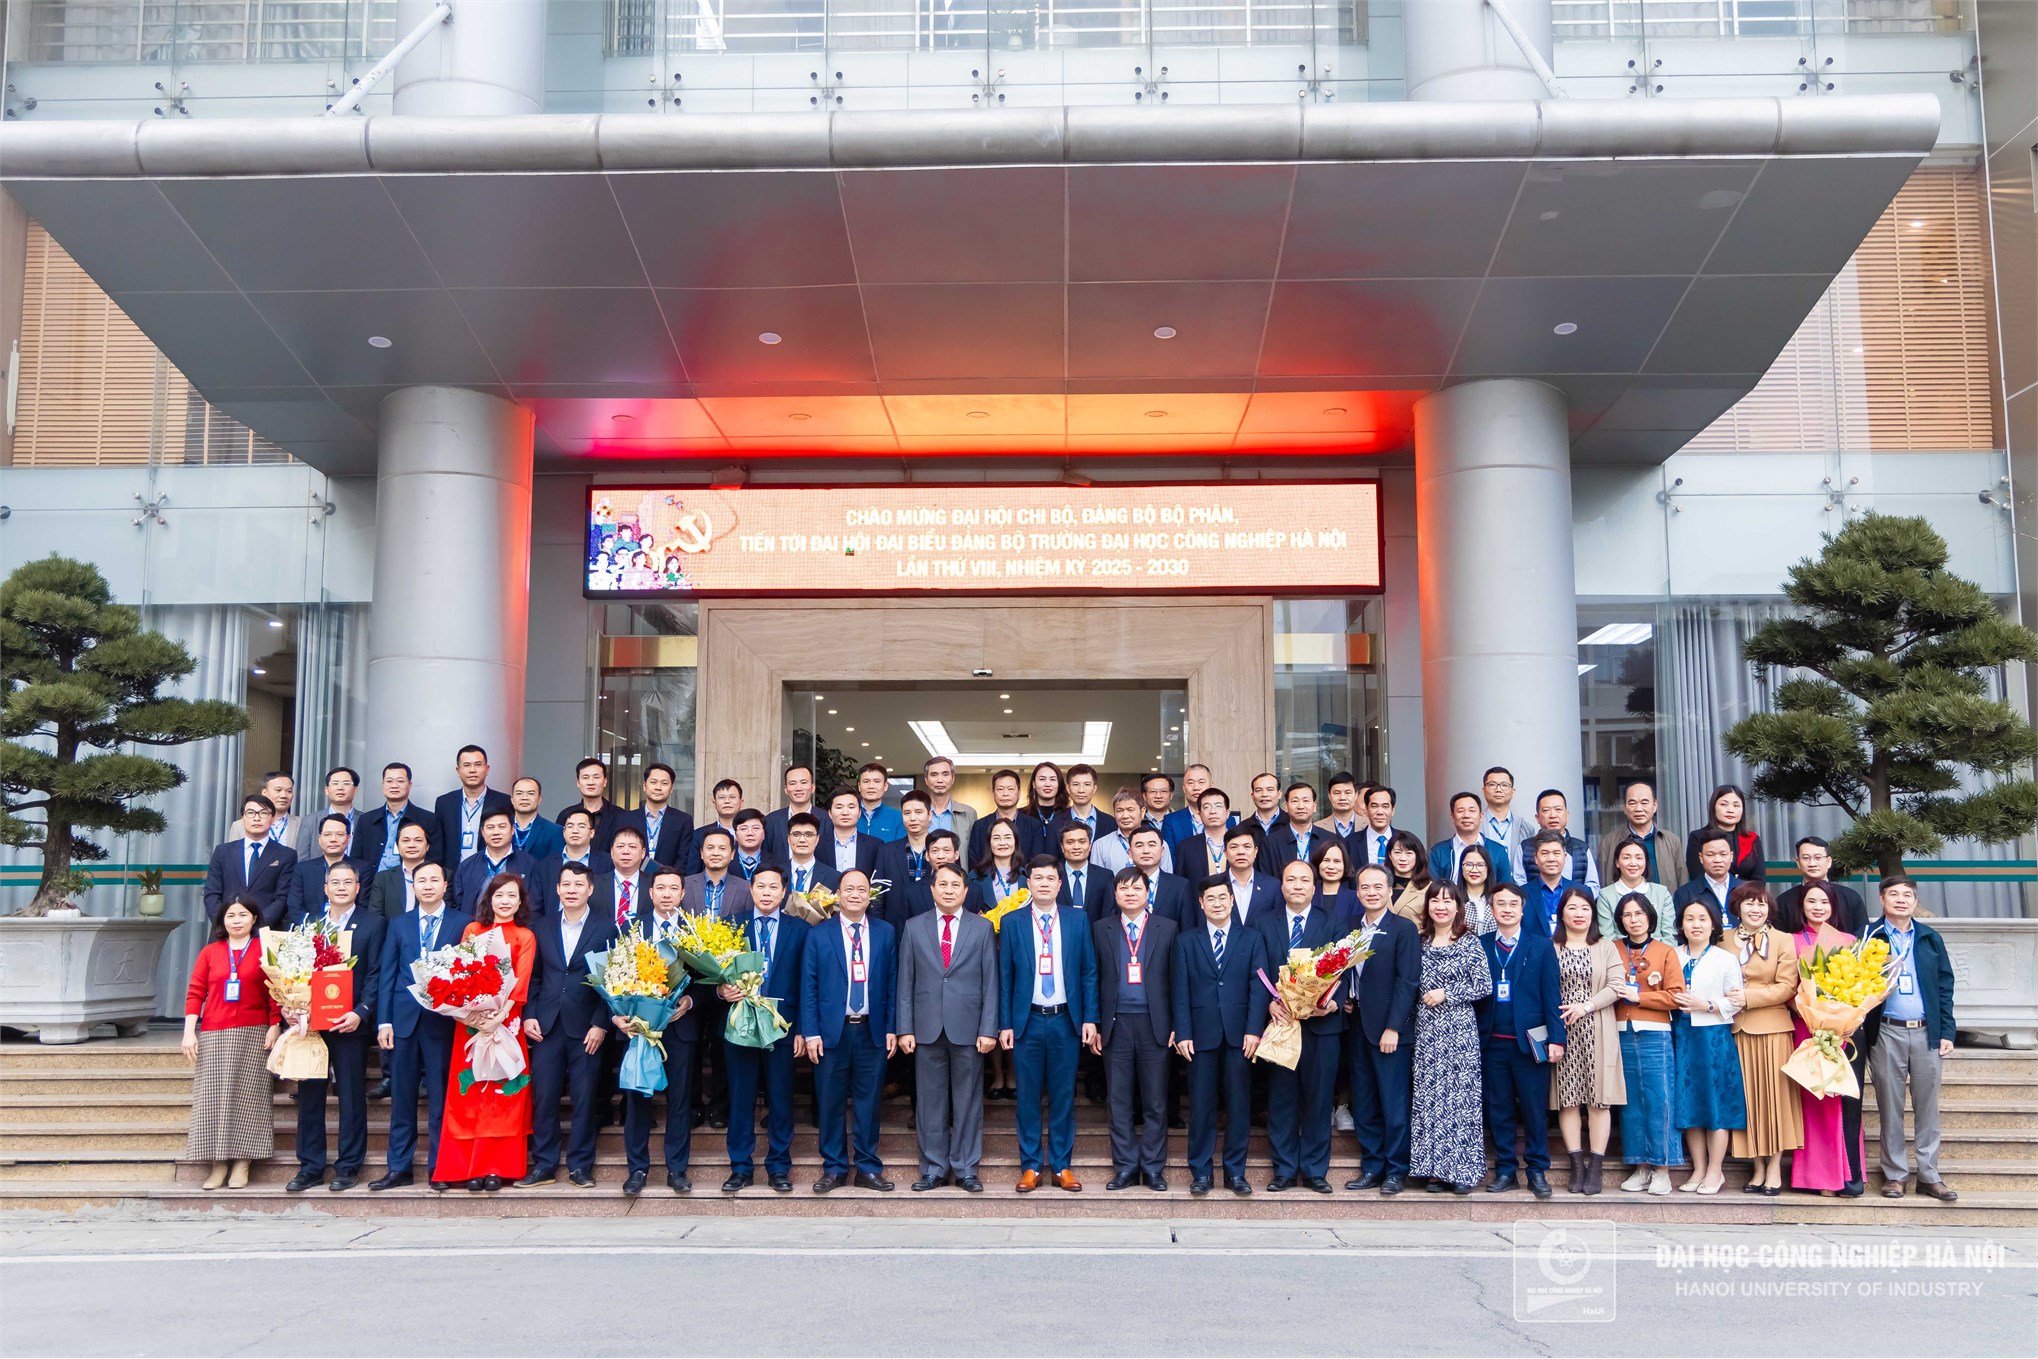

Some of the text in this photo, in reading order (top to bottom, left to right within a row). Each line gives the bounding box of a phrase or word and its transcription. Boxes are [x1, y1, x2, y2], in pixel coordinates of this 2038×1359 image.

[845, 507, 893, 526] CHÀO
[896, 507, 947, 525] MỪNG
[950, 508, 980, 529] ĐẠI
[983, 505, 1013, 529] HỘI
[1016, 508, 1043, 525] CHI
[1050, 504, 1078, 528] BỘ,
[1081, 503, 1128, 525] ĐẢNG
[1132, 503, 1156, 527] BỘ
[1160, 503, 1184, 527] BỘ
[740, 527, 1347, 555] TIẾN TỚI ĐẠI HỘI ĐẠI BIỂU ĐẢNG BỘ TRƯỜNG ĐẠI HỌC CÔNG NGHIỆP HÀ NỘI
[896, 554, 929, 577] LẦN
[932, 556, 966, 577] THỨ
[970, 559, 1001, 578] VIII,
[1004, 555, 1061, 578] NHIỆM
[1065, 557, 1087, 576] KỲ
[1091, 559, 1133, 576] 2025
[1147, 558, 1189, 576] 2030
